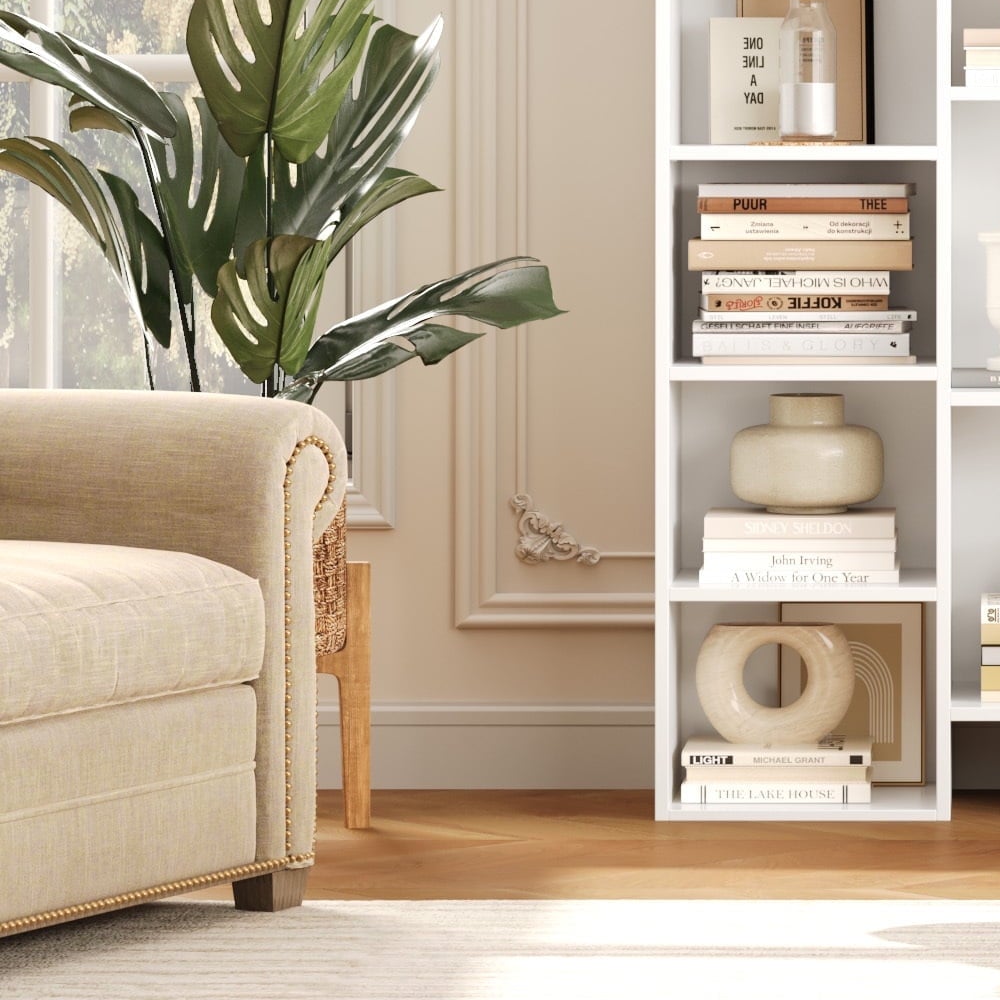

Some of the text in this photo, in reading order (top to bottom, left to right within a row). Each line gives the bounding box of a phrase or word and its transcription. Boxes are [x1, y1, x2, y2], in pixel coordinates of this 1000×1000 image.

[733, 199, 767, 210] PUUR
[859, 198, 887, 210] THEE
[715, 277, 888, 288] WHO IS MICHAEL JANG?
[788, 297, 842, 309] KOFFIE
[744, 522, 852, 534] SIDNEY SHELDON
[771, 555, 833, 568] John Irving
[731, 572, 870, 583] A Widow for One Year
[692, 755, 729, 765] LIGHT
[753, 756, 826, 764] MICHAEL GRANT
[715, 789, 836, 799] THE LAKE HOUSE
